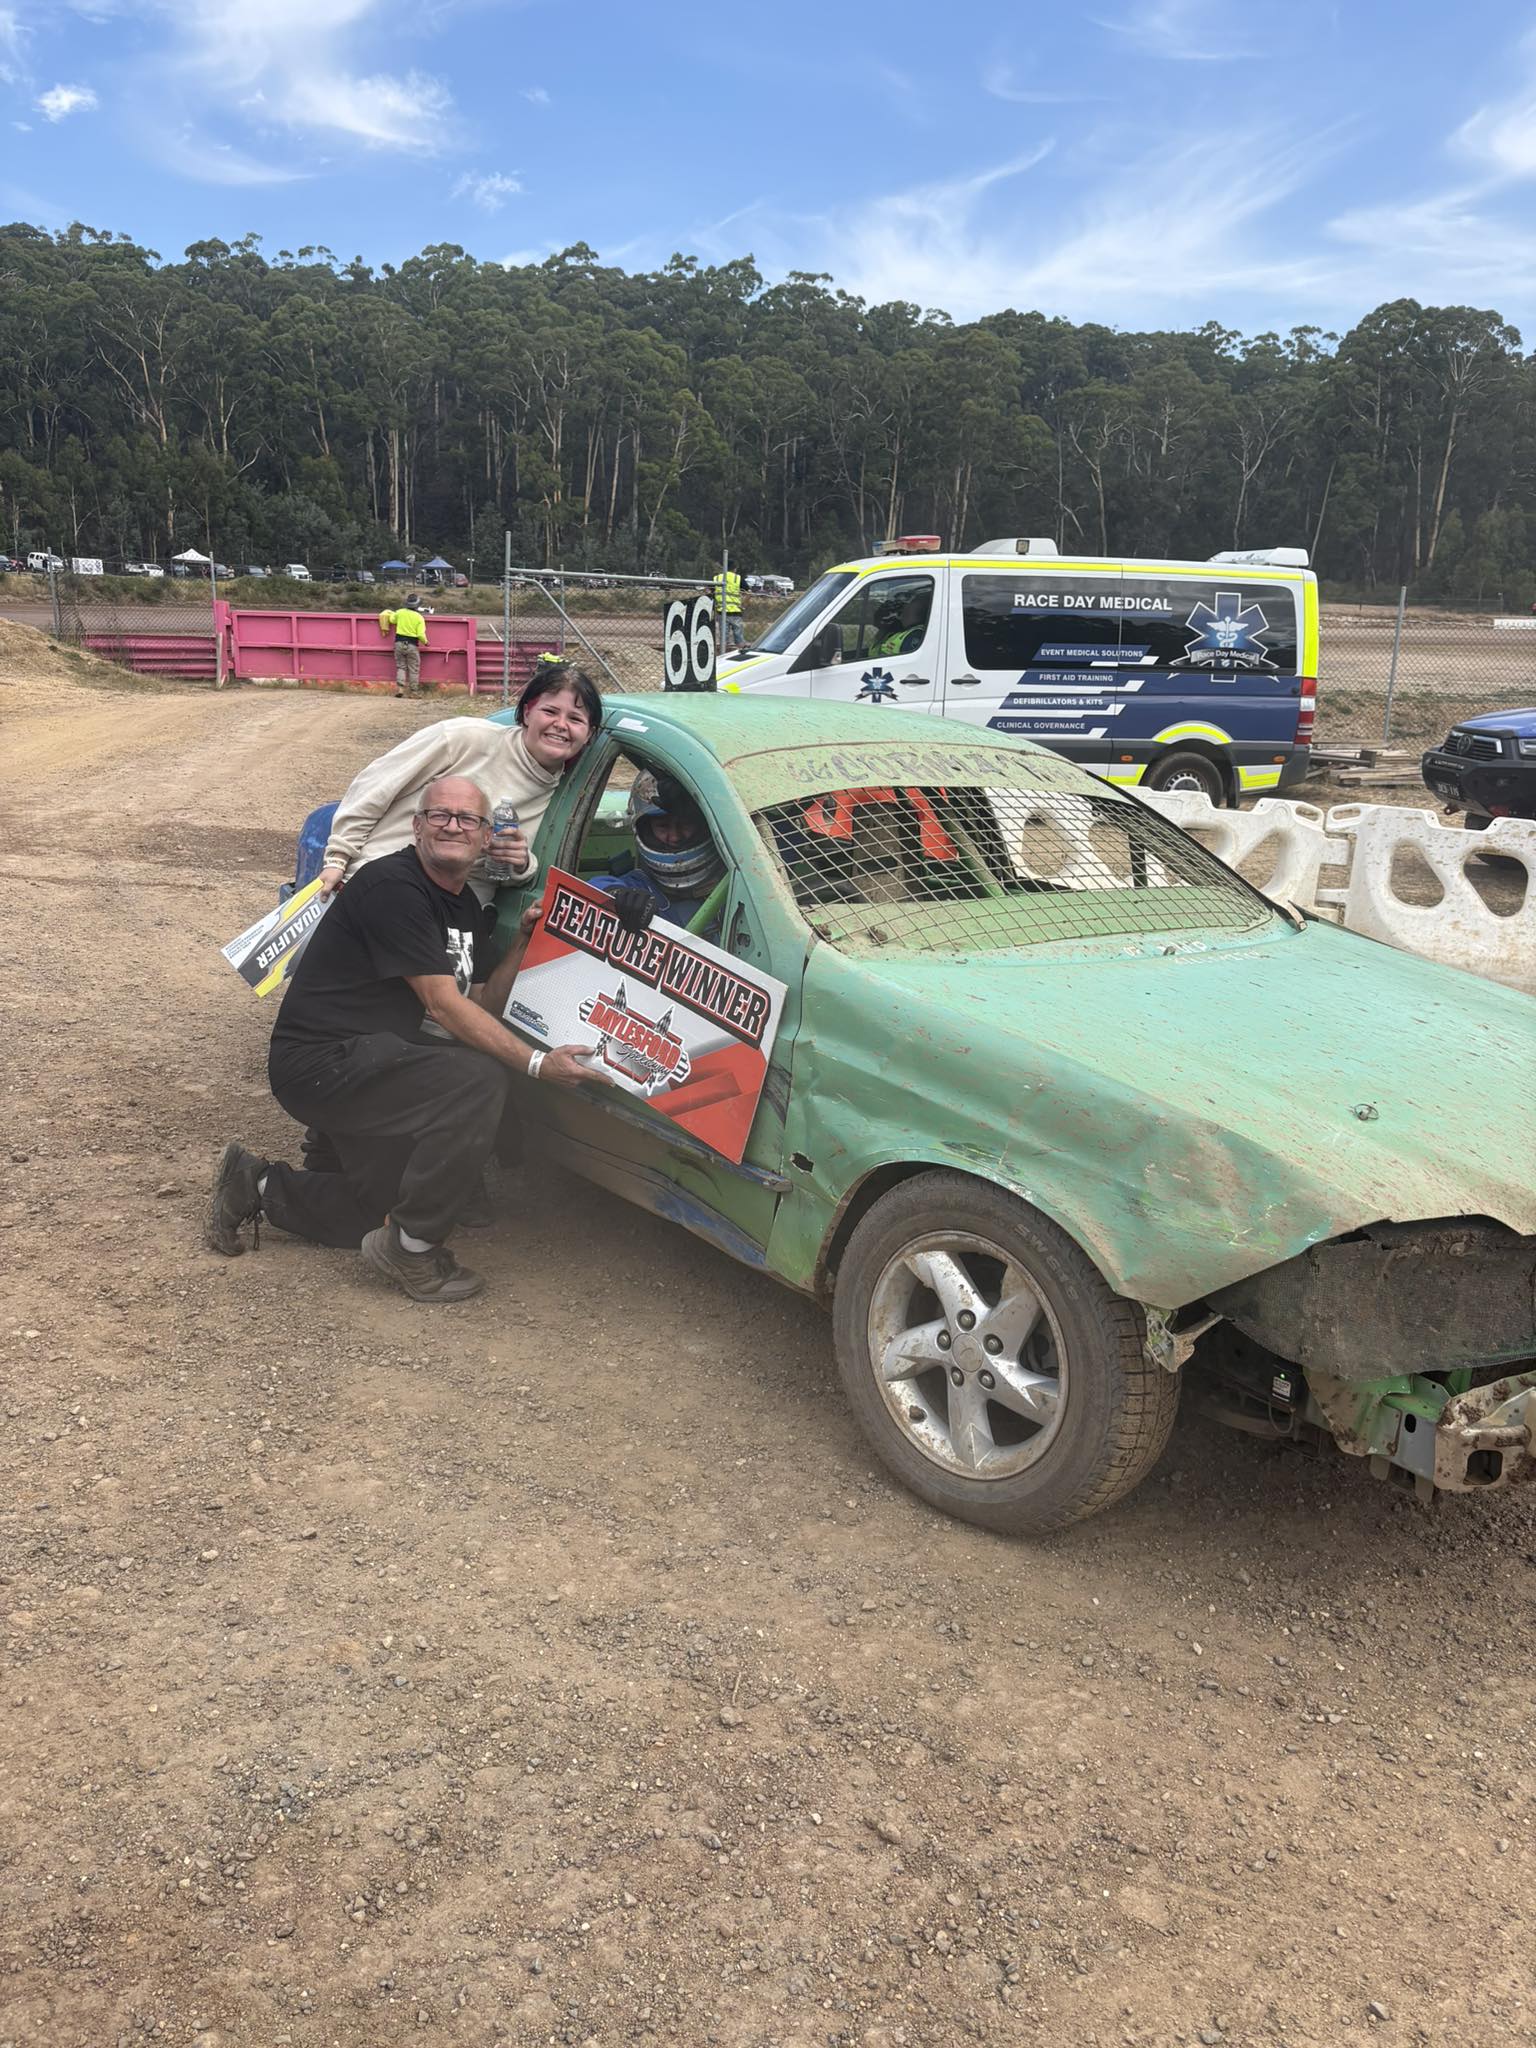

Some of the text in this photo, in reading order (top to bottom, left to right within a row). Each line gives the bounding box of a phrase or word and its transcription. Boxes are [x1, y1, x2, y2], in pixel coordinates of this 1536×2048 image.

[1014, 594, 1173, 610] RACE DAY MEDICAL
[665, 595, 715, 685] 66
[1066, 649, 1100, 657] MEDICAL
[1215, 650, 1229, 658] Day
[1229, 650, 1256, 661] Medical
[1077, 674, 1114, 682] TRAINING
[996, 721, 1032, 729] CLINICAL
[255, 902, 322, 970] QUALIFIER
[548, 888, 769, 1039] FEATURE WINNER
[586, 1000, 682, 1071] DAYLESFORD
[616, 1042, 671, 1082] Speedway
